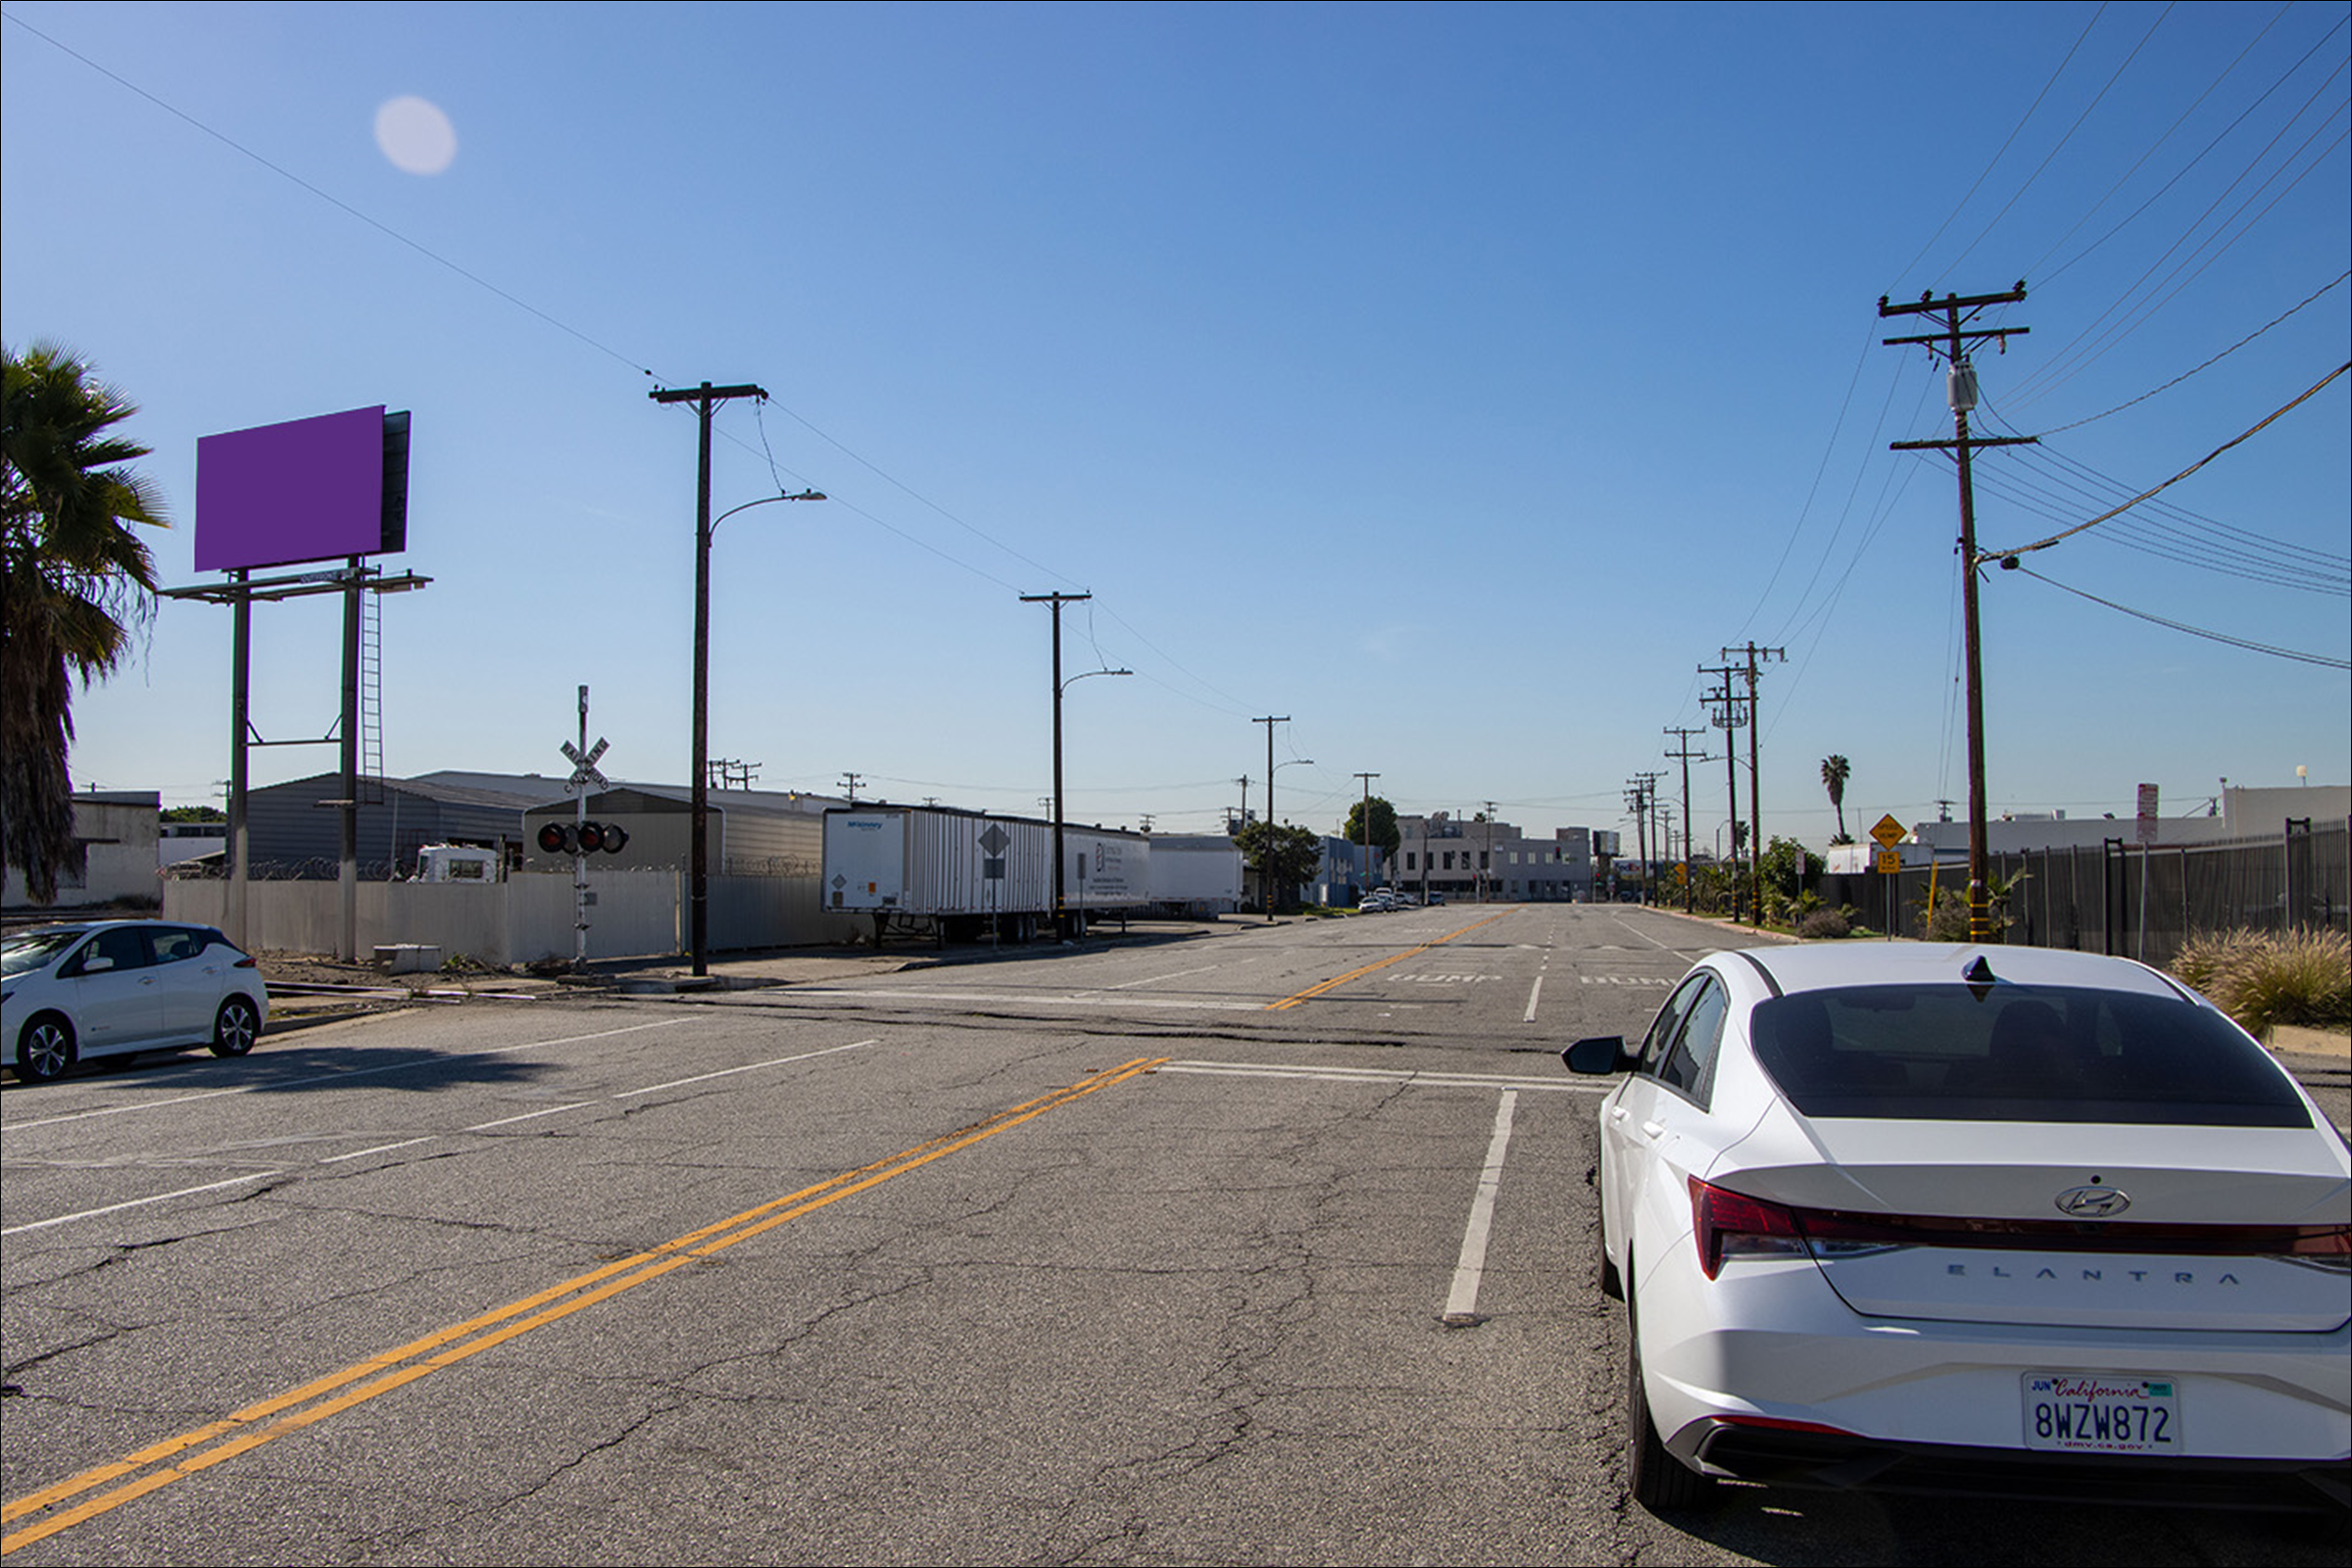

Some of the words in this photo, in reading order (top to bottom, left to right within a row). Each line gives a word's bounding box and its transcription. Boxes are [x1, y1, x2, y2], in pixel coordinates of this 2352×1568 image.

[1883, 854, 1895, 865] 15
[1947, 1264, 2239, 1285] ELANTRA
[2032, 1380, 2051, 1391] JUN
[2055, 1378, 2150, 1402] California
[2035, 1403, 2171, 1443] 8WZW872
[2064, 1441, 2143, 1450] dmv.ca.gov
